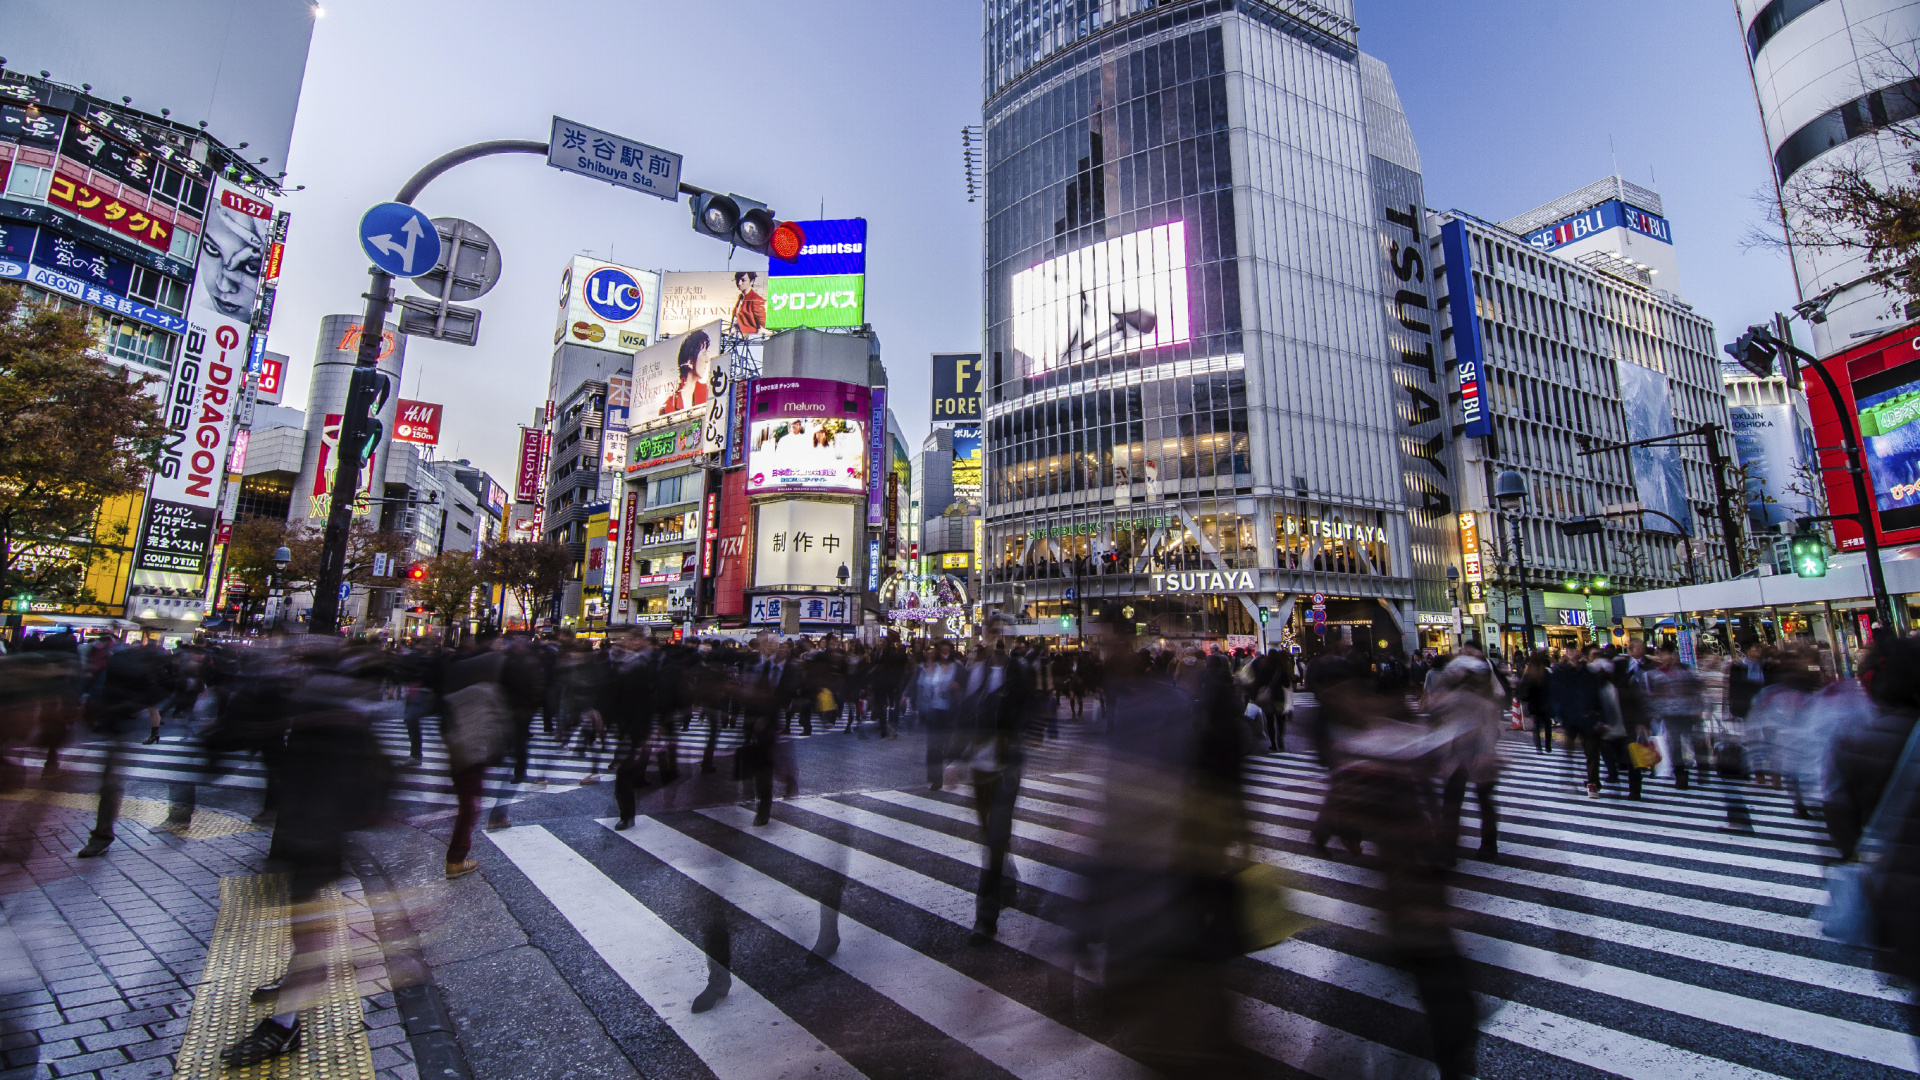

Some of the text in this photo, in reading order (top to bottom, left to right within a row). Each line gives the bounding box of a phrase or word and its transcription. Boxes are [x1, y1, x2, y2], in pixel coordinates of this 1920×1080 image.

[562, 127, 671, 178] 渋谷駅前
[577, 156, 656, 189] Shibuya Sta.
[22, 207, 36, 217] 7F
[52, 176, 168, 239] コンタクト
[228, 194, 264, 216] 11.27
[51, 214, 63, 225] 7F
[1625, 208, 1668, 240] SEIBU
[1530, 210, 1605, 249] SEIBU
[664, 285, 703, 295] 三浦大知
[35, 270, 185, 330] AEON 英会話イーオン
[663, 300, 687, 308] THE
[771, 291, 857, 311] サロンパス
[190, 322, 208, 333] from
[622, 335, 646, 347] VISA
[1386, 204, 1452, 523] TSUTAYA
[1458, 361, 1481, 424] SEIBU
[185, 324, 240, 498] G-DRAGON
[404, 405, 434, 423] H&M
[705, 366, 728, 449] もんじゃ
[784, 402, 826, 412] Melumo
[935, 397, 982, 415] FORE
[412, 431, 434, 440] 150m
[611, 442, 626, 451] まで
[651, 438, 675, 457] 西村
[871, 404, 884, 490] Taisei neon
[519, 429, 539, 498] Essential
[154, 502, 193, 517] ジャパン
[152, 514, 207, 529] ソロデビュー
[1029, 515, 1172, 540] STARBUCKS COFFEE
[150, 525, 180, 538] にして
[644, 531, 683, 545] Euphoria
[1310, 520, 1387, 544] TSUTAYA
[773, 531, 840, 554] 制作中
[143, 554, 201, 567] COUP D'ETAT
[1468, 562, 1479, 574] 本
[1151, 571, 1255, 592] TSUTAYA
[754, 599, 846, 618] 大盛書店
[1419, 614, 1449, 623] TSUTAYA
